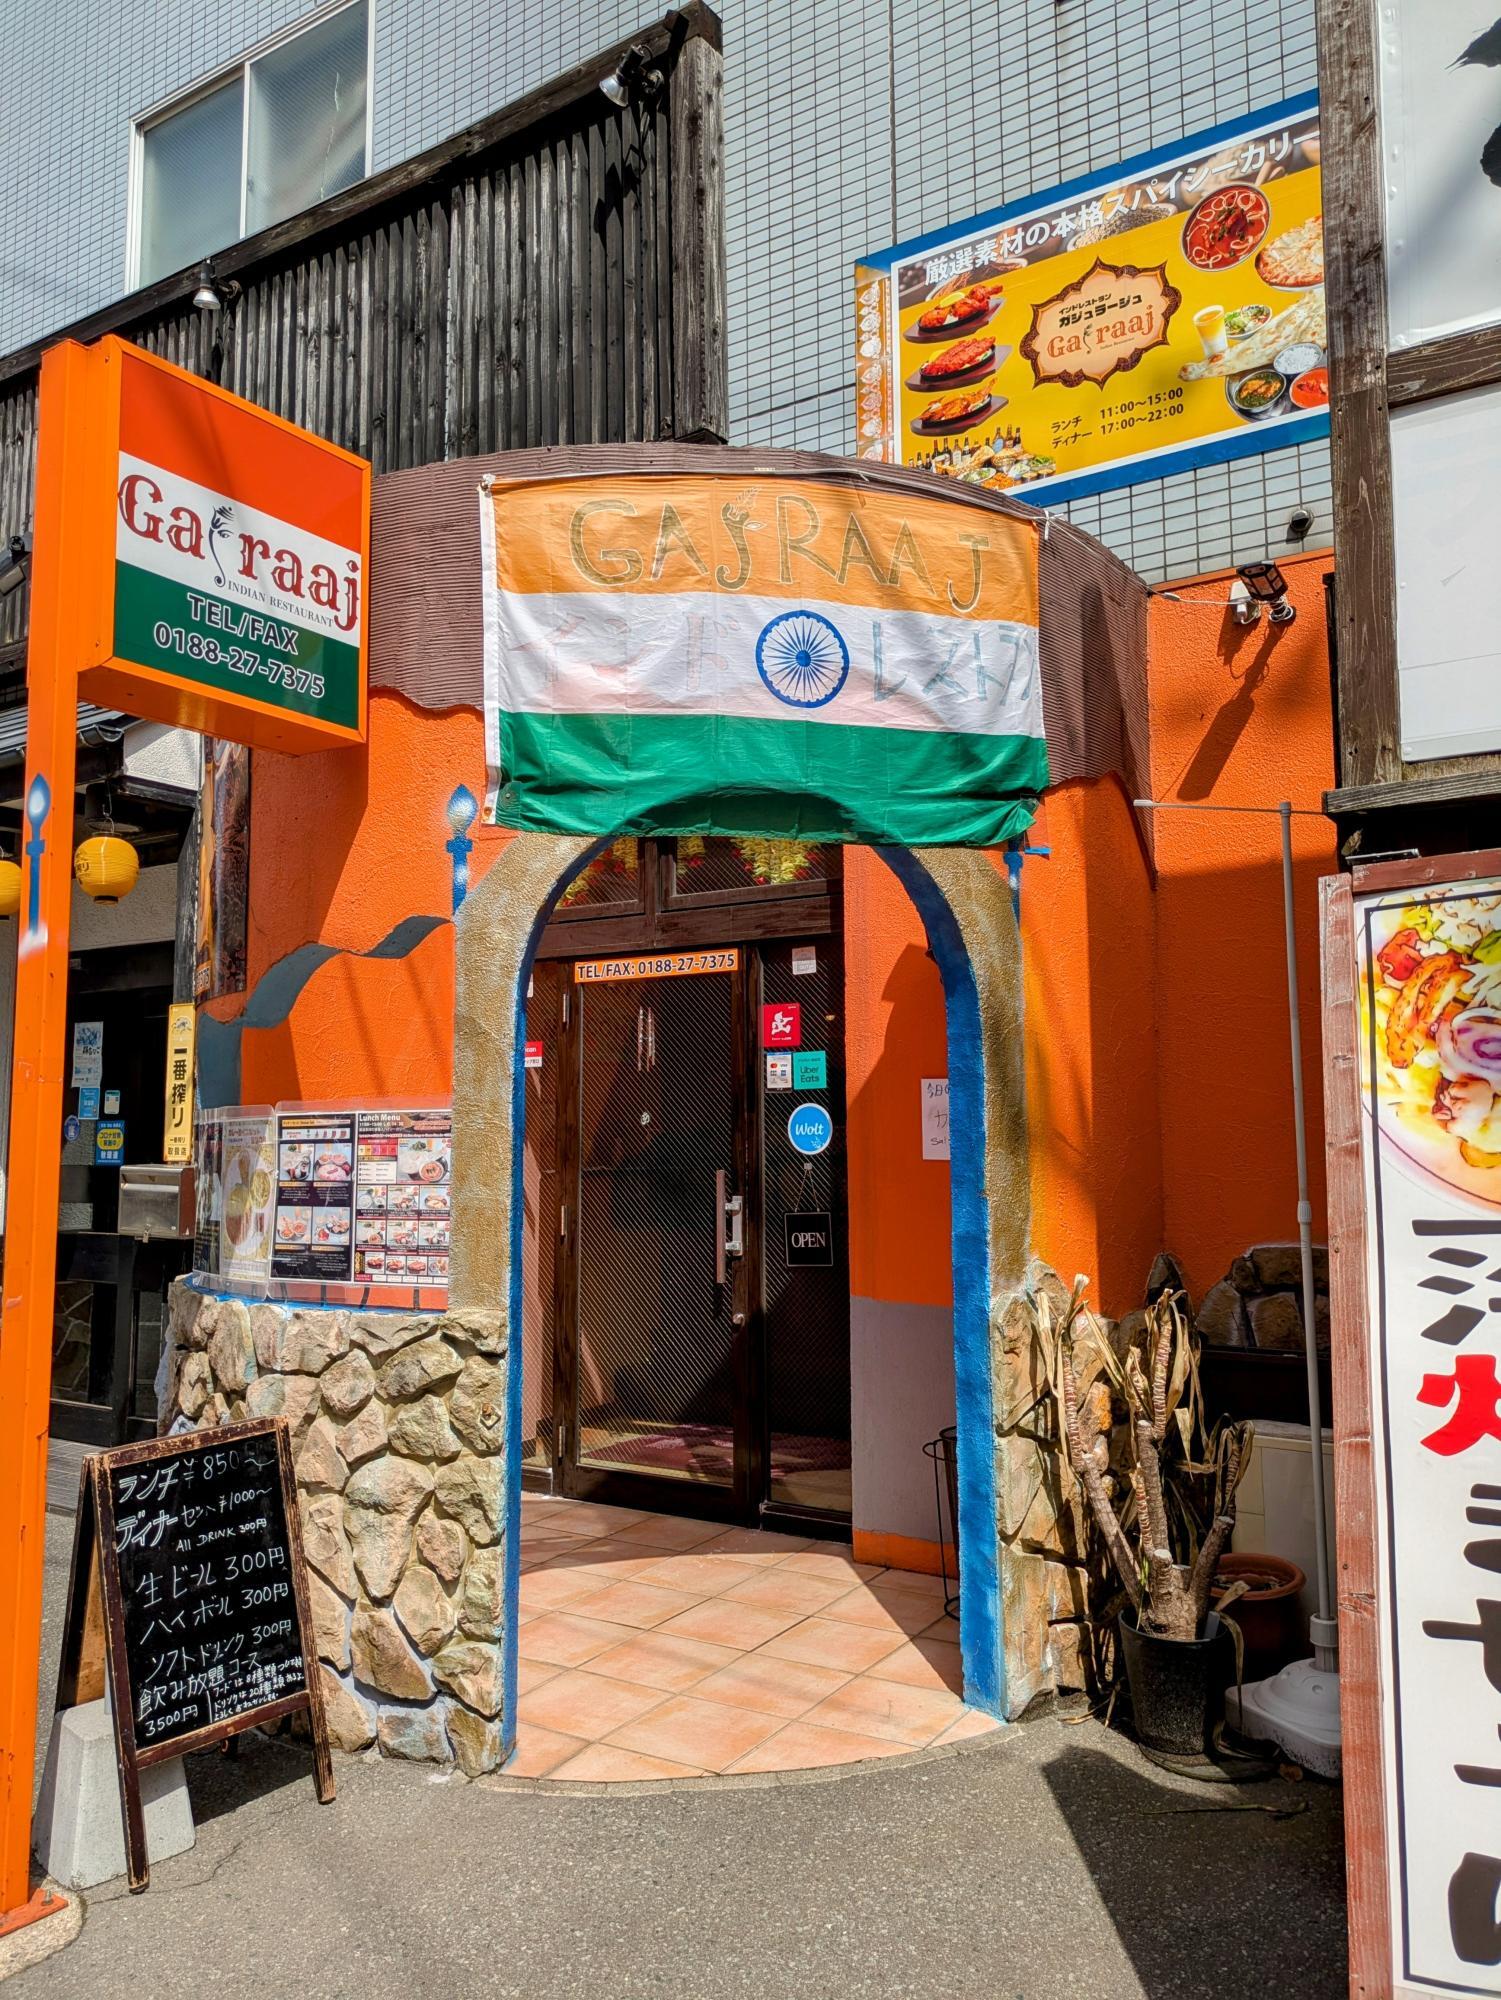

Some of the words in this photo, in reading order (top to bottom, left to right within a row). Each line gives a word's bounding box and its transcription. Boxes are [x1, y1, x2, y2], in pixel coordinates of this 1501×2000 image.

[1051, 415, 1082, 434] ランチ
[1051, 431, 1093, 449] ディナー
[228, 580, 266, 602] INDIAN
[269, 595, 334, 628] RESTAURANT
[187, 592, 299, 655] TEL/FAX
[153, 620, 325, 699] 0188-27-7375
[577, 962, 635, 979] TEL/FAX:
[638, 953, 735, 974] 0188-27-7375
[800, 1066, 819, 1074] Uber
[800, 1075, 820, 1083] Eats
[171, 1048, 188, 1128] 一番搾り
[359, 1112, 379, 1122] Lunch
[380, 1112, 401, 1121] Menu
[795, 1122, 825, 1136] Wolt
[791, 1231, 827, 1248] OPEN
[118, 1461, 180, 1503] ランチ
[196, 1527, 236, 1547] DRINK
[238, 1518, 267, 1534] 300円
[225, 1546, 285, 1581] 300円
[139, 1594, 234, 1645] ハイボール
[241, 1582, 289, 1609] 300円
[251, 1619, 292, 1645] 300円
[145, 1704, 199, 1737] 3500円
